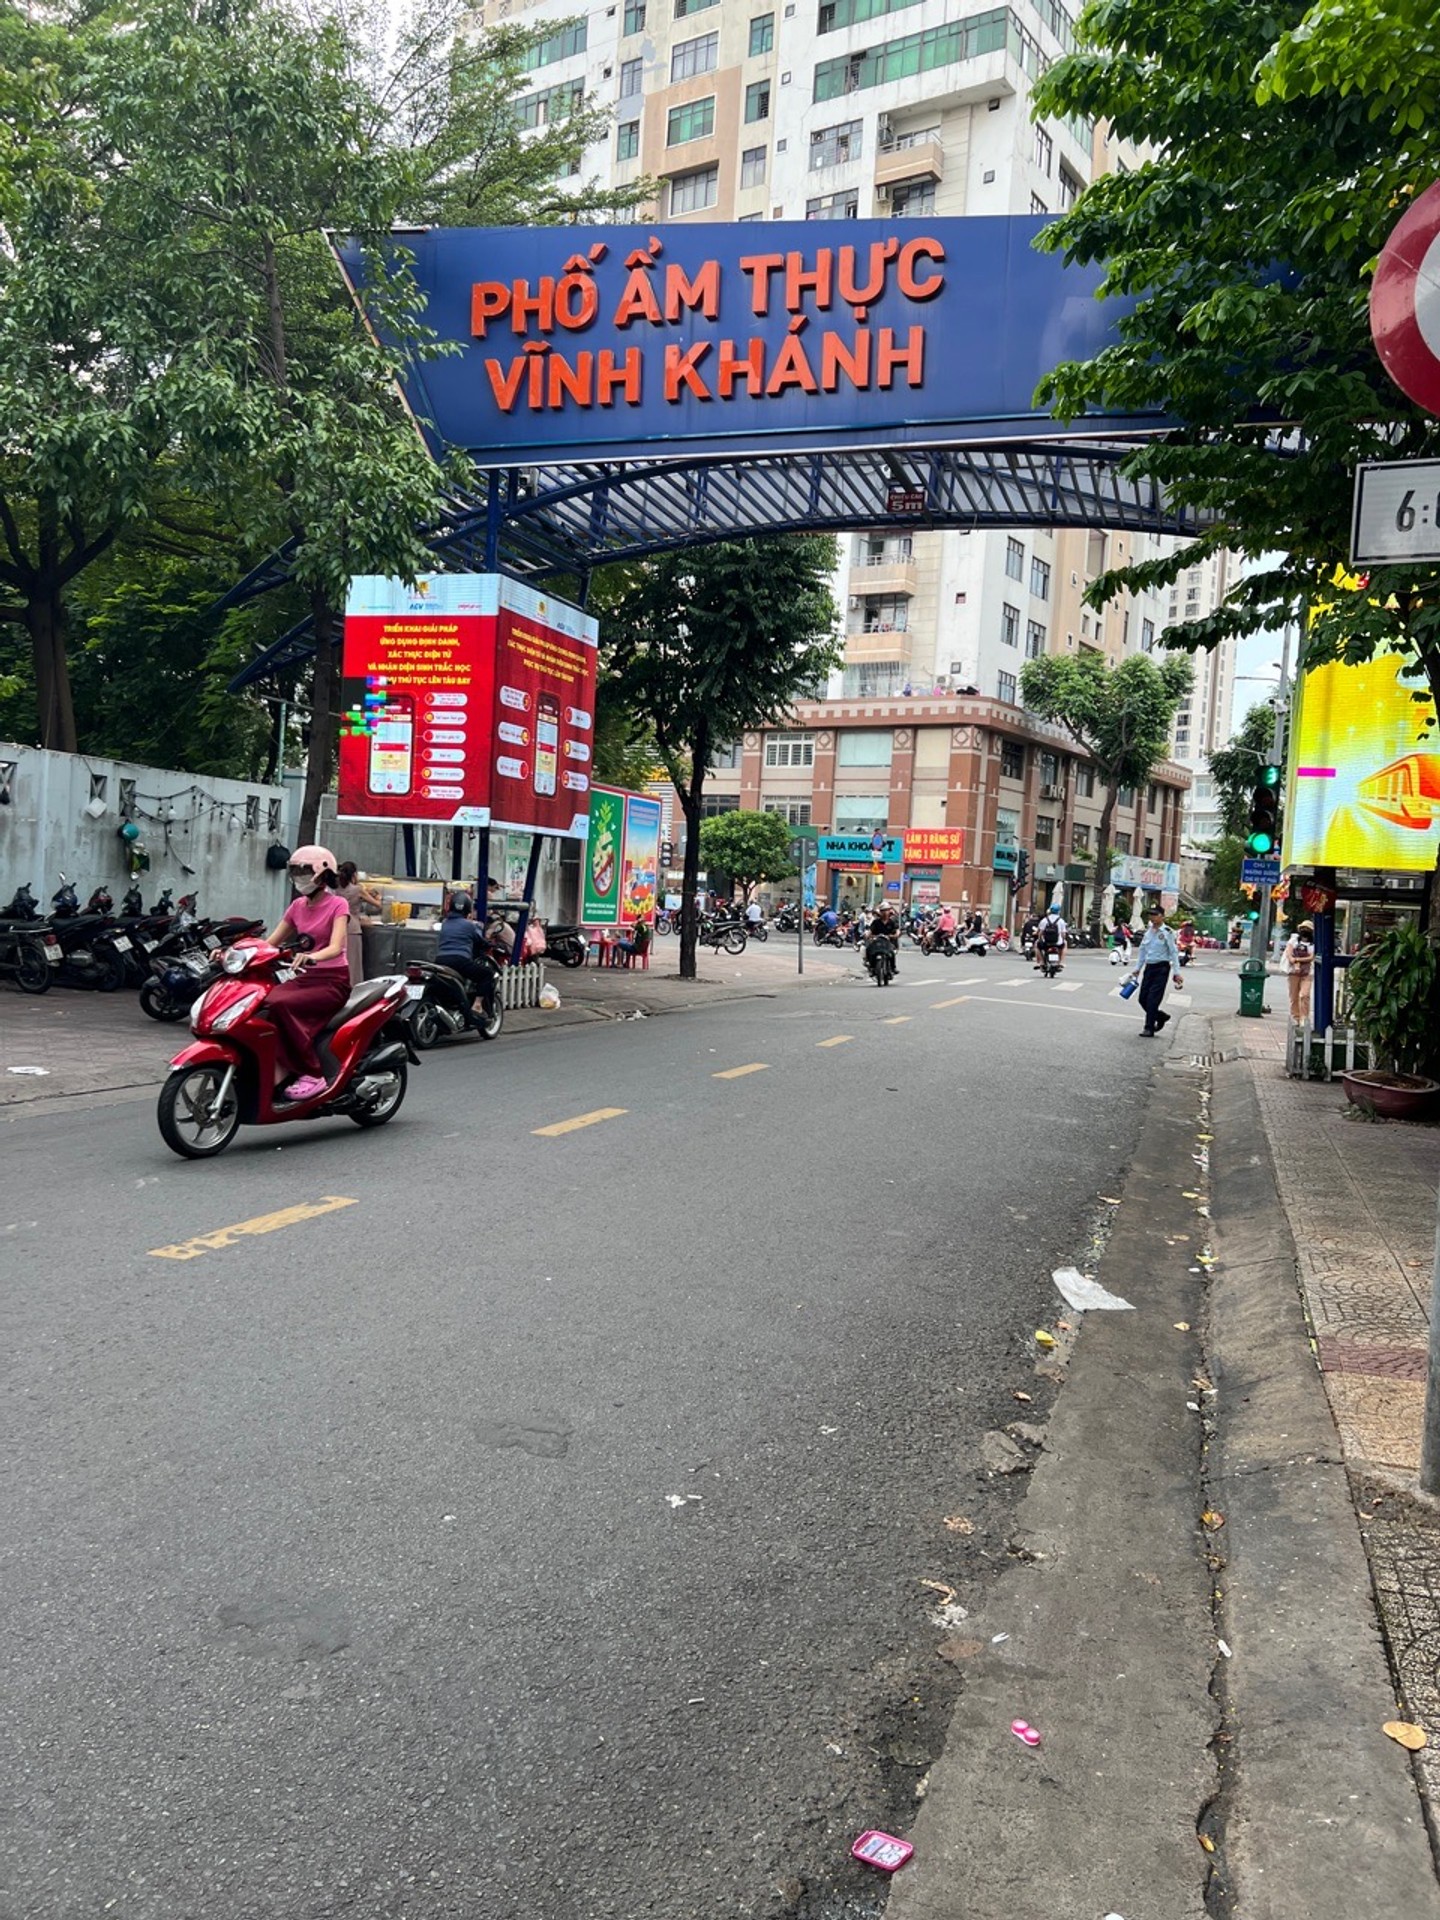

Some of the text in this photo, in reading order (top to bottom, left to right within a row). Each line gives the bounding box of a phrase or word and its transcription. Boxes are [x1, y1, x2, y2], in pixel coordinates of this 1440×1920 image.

[471, 236, 945, 338] PHỐ ẨM THỰC
[485, 315, 924, 411] VĨNH KHÁNH
[892, 500, 923, 511] 5m
[826, 841, 846, 850] NHA
[923, 848, 928, 859] 1
